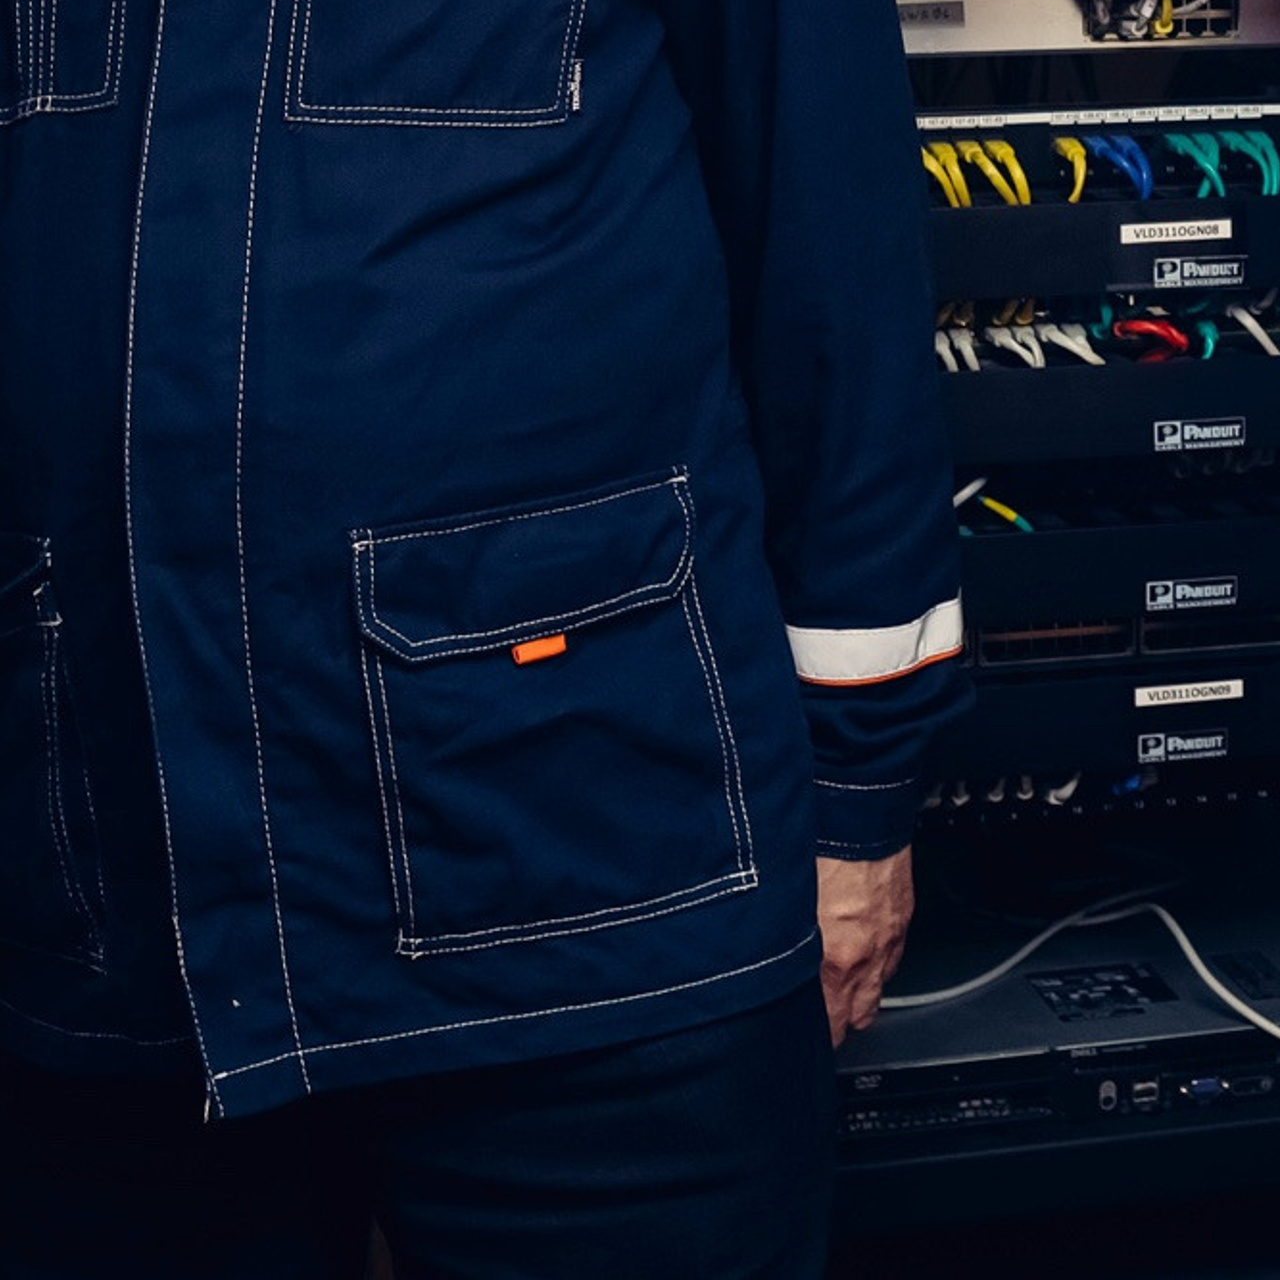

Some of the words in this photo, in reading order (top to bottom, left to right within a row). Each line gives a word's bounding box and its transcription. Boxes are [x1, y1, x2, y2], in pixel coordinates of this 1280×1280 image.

[1133, 224, 1220, 238] VLD311OGN08
[1183, 262, 1240, 277] PANDUIT
[1184, 424, 1241, 439] PANDUIT
[1176, 584, 1232, 599] PANDUIT
[1147, 685, 1231, 701] VLD311OGN09
[1167, 736, 1223, 752] PANDUIT
